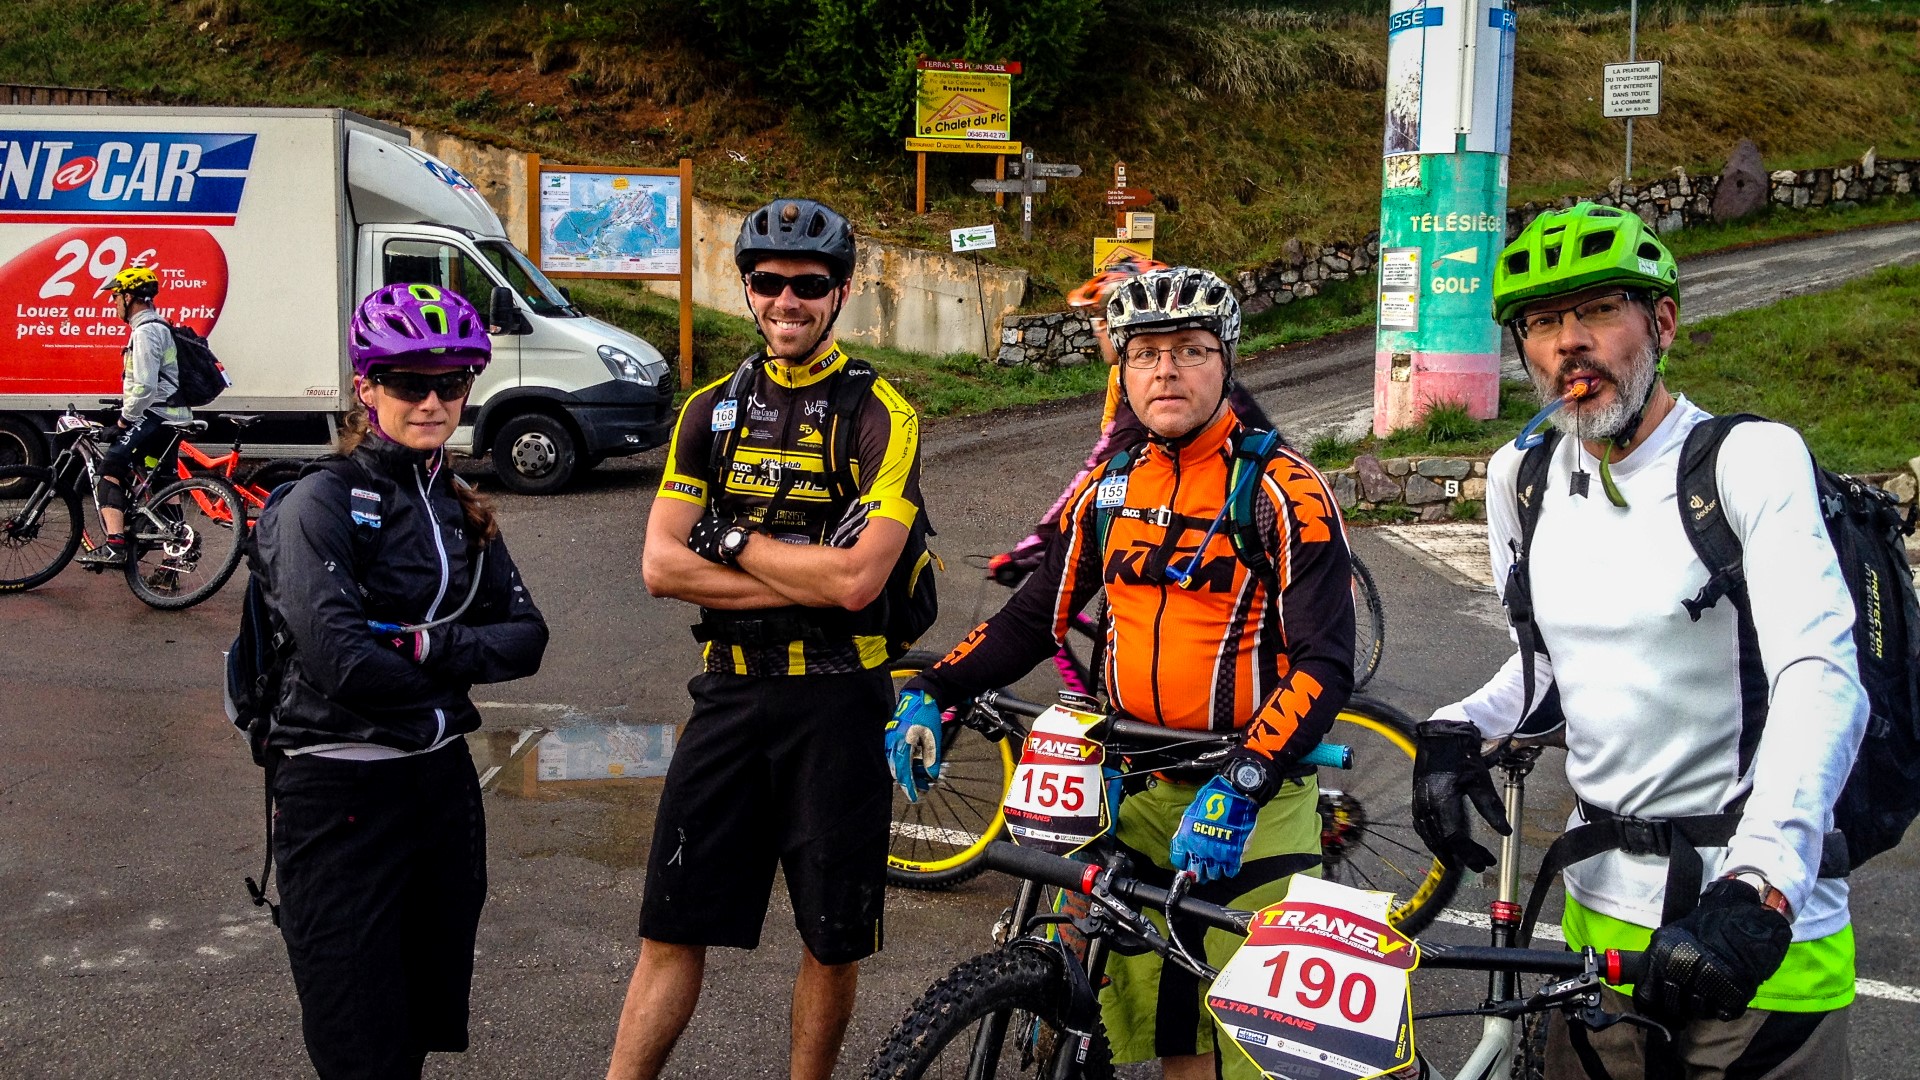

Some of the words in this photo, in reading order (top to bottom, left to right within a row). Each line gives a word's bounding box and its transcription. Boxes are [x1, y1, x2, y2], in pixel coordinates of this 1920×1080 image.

[1616, 74, 1658, 82] TOUT-TERRAIN
[1620, 98, 1651, 106] COMMUNE
[920, 126, 932, 134] Le
[935, 118, 970, 132] Chalet
[974, 116, 987, 126] du
[991, 112, 1006, 123] Pic
[1410, 211, 1502, 232] TÉLÉSIÈGE
[162, 269, 185, 278] TTC
[1431, 277, 1480, 294] GOLF
[16, 304, 68, 318] Louez
[74, 306, 96, 318] au
[180, 304, 215, 322] prix
[16, 322, 54, 339] près
[60, 321, 80, 335] de
[86, 321, 126, 336] chez
[716, 410, 734, 422] 168
[732, 462, 752, 472] evoc
[1102, 486, 1123, 498] 155
[1447, 483, 1456, 494] 5
[1696, 500, 1716, 520] deuter
[1864, 562, 1876, 652] INTEGRATED
[1870, 569, 1882, 659] PROTECTOR
[1244, 670, 1323, 760] KTM
[1022, 768, 1085, 812] 155
[1004, 806, 1022, 818] ULTRA
[1022, 811, 1052, 822] TRANS
[1192, 821, 1233, 841] SCOTT
[1108, 899, 1126, 912] XT
[1263, 910, 1408, 955] TRANSV
[1263, 950, 1377, 1023] 190
[1556, 980, 1574, 992] XT
[1210, 998, 1258, 1017] ULTRA
[1263, 1008, 1317, 1032] TRANS
